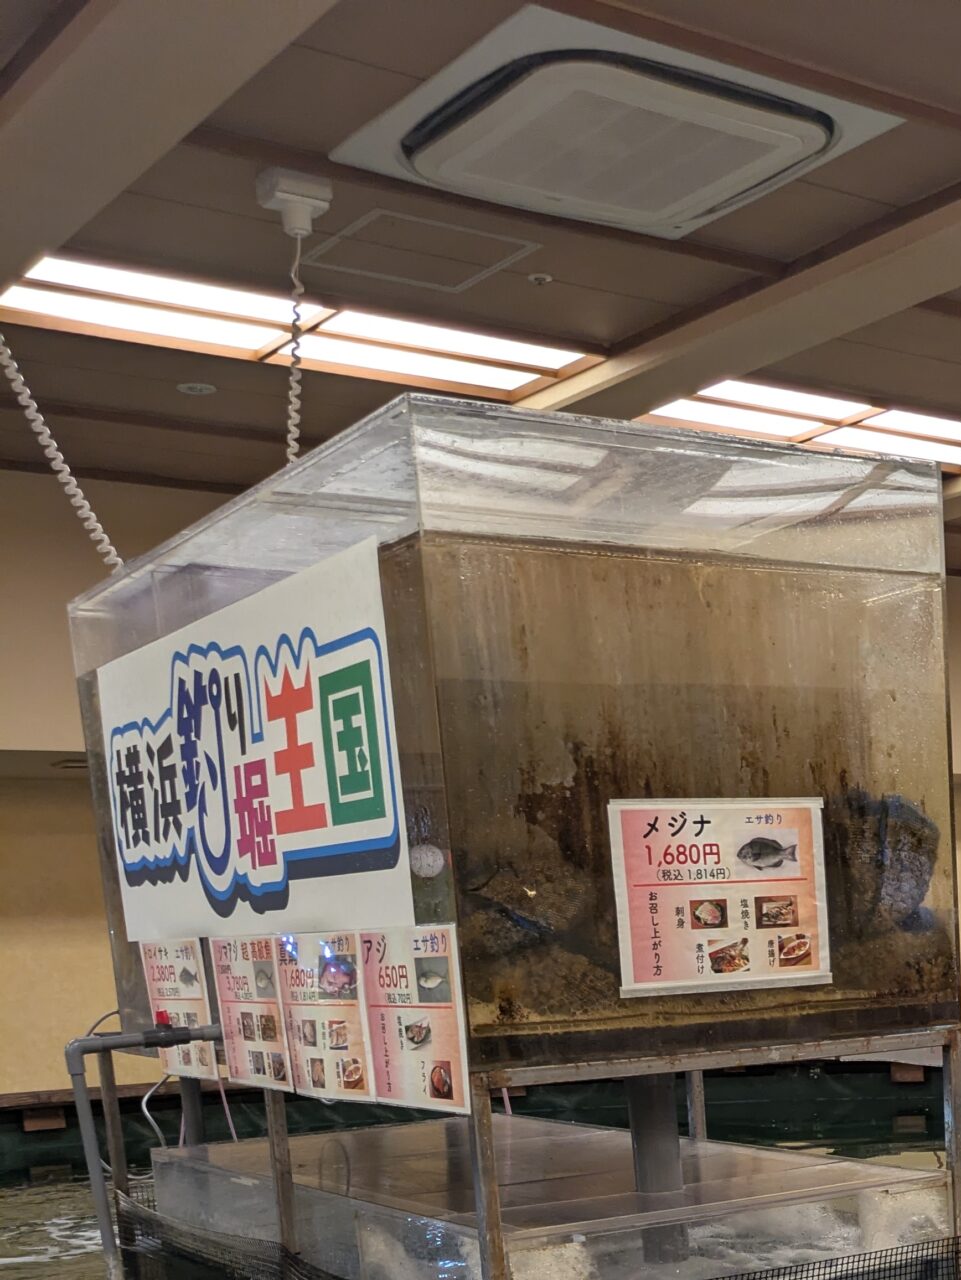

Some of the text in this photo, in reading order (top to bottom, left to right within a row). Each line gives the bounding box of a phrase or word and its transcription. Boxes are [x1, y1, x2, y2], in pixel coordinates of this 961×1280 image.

[114, 657, 387, 876] 横浜釣り堀王国
[643, 811, 711, 839] メジナ
[745, 813, 783, 826] エサ釣り
[645, 843, 721, 867] 1,680円
[674, 905, 686, 929] 刺身
[413, 933, 448, 953] エサ釣り
[648, 890, 663, 977] お召し上がり方
[362, 935, 388, 965] アジ
[284, 967, 315, 989] 1,680円
[378, 965, 409, 989] 650円
